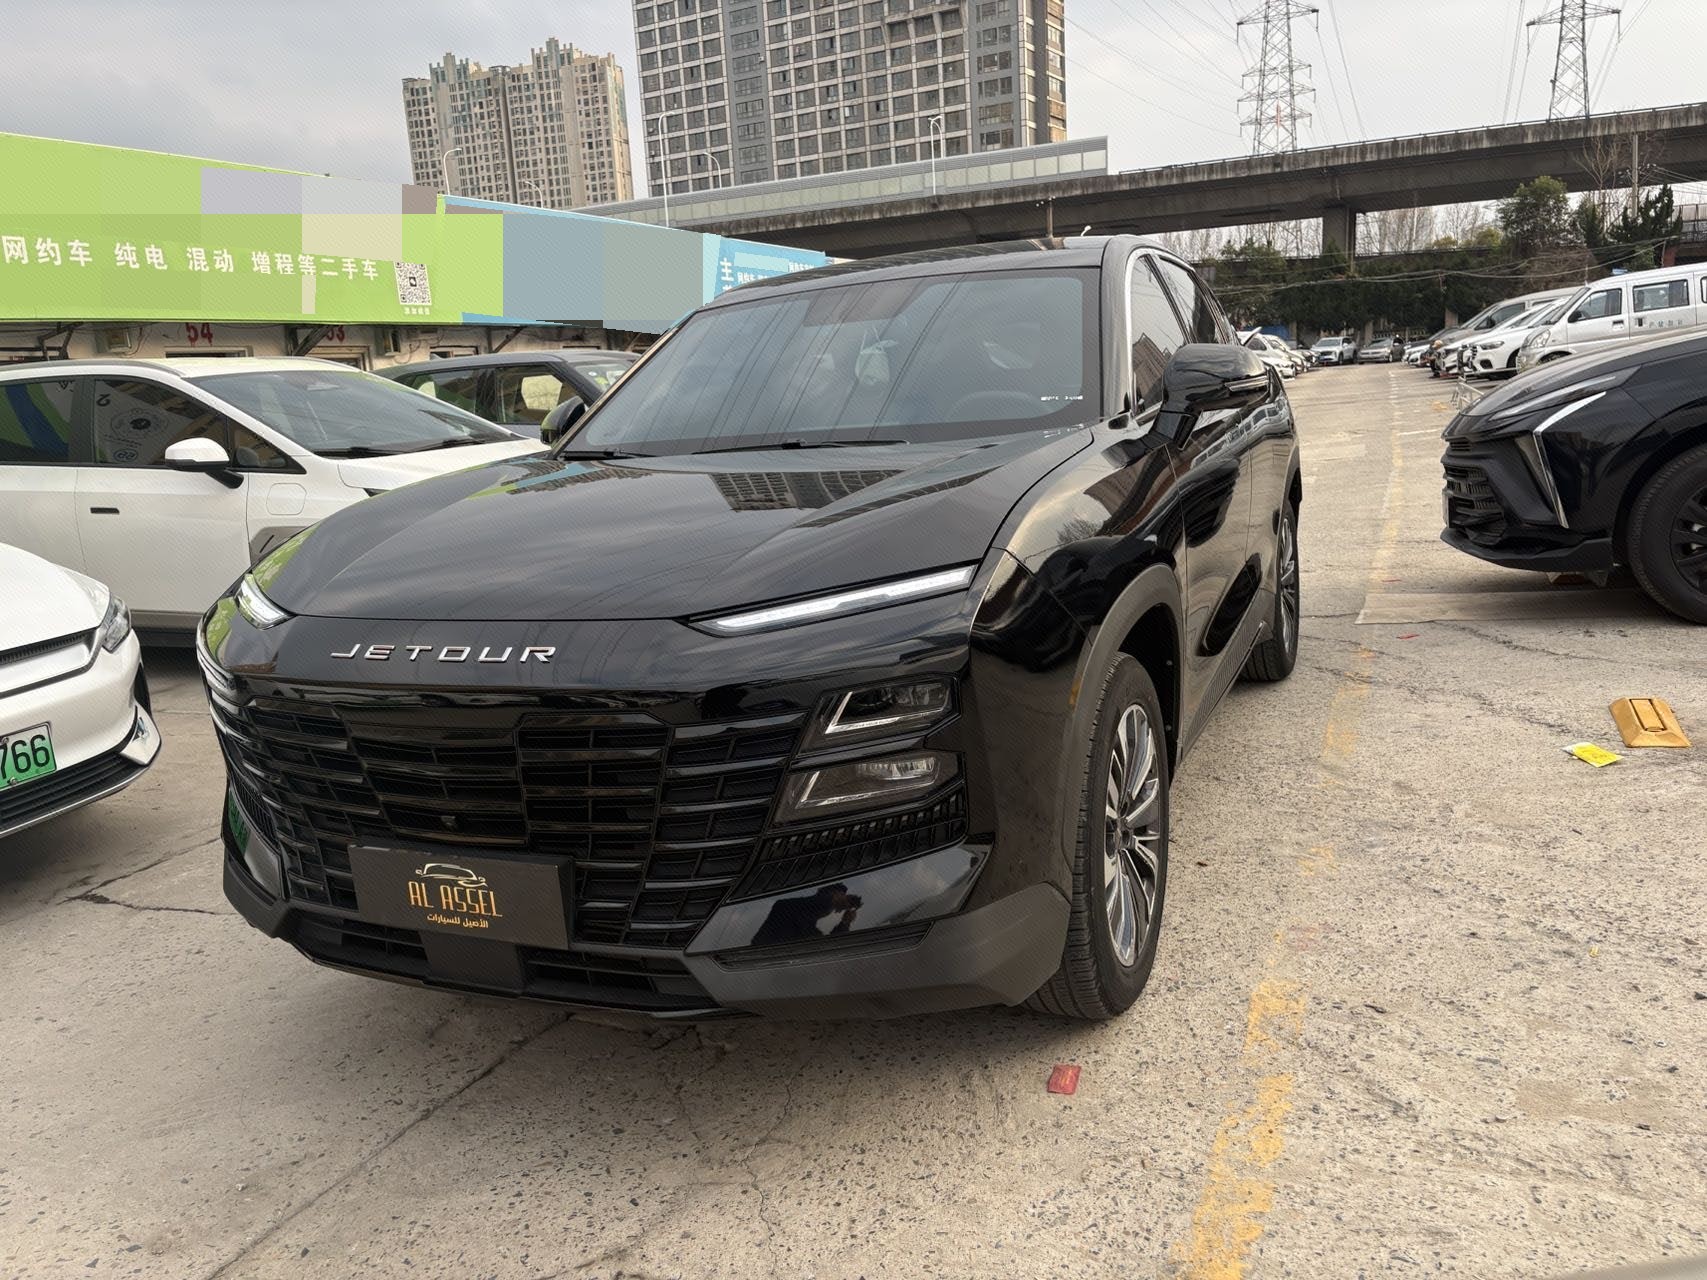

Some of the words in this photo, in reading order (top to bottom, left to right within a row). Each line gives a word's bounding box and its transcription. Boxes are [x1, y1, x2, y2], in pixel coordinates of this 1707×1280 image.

[1, 235, 93, 267] 网约车
[114, 241, 168, 270] 纯电
[186, 247, 234, 273] 混动
[251, 250, 379, 281] 增程等二手车
[185, 322, 213, 346] 54
[330, 643, 557, 663] JETOUR
[0, 734, 50, 779] 766
[408, 881, 434, 908] AL
[440, 885, 503, 918] ASSEL
[427, 913, 460, 925] للسيارات
